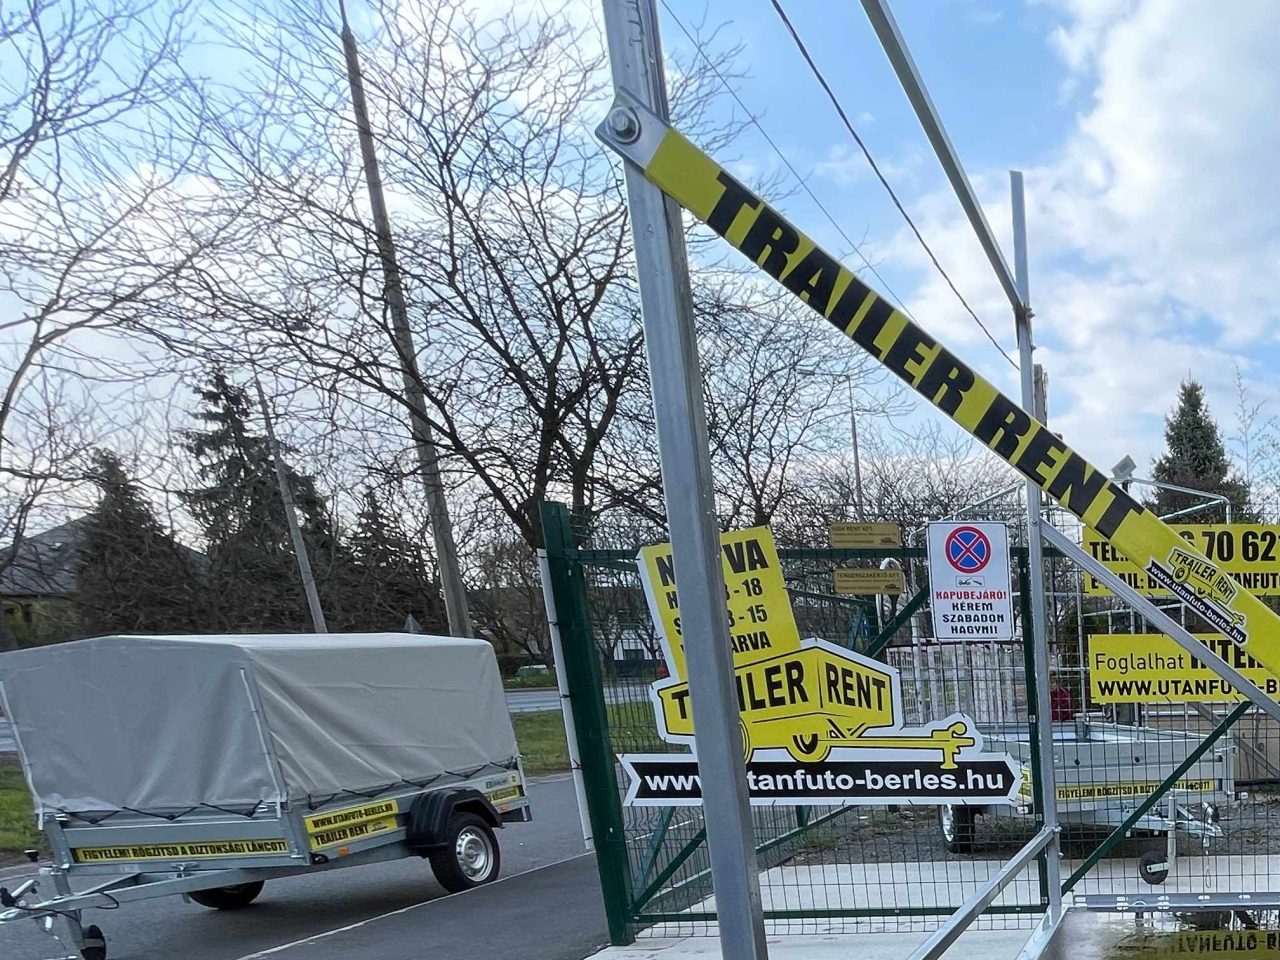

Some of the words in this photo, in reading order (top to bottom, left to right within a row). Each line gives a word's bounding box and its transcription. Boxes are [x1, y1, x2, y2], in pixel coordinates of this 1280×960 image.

[706, 170, 976, 416] TRAILER
[974, 393, 1145, 541] RENT
[1202, 531, 1234, 562] 70
[656, 538, 769, 586] NVA
[742, 577, 763, 597] 18
[1090, 572, 1144, 590] EAIL:
[1175, 552, 1217, 582] TRAILER
[1214, 574, 1233, 600] RENT
[747, 603, 768, 624] 15
[952, 600, 993, 611] KÉREM
[1151, 565, 1244, 642] www.utanfuto-berles.hu
[942, 614, 1005, 623] SZABADON
[1095, 652, 1184, 674] Foglalhat
[672, 660, 809, 719] TILER
[825, 661, 886, 712] RENT
[645, 767, 1004, 790] wwtanfuto-berles.hu
[315, 830, 349, 846] TRAILER
[349, 824, 369, 838] RENT
